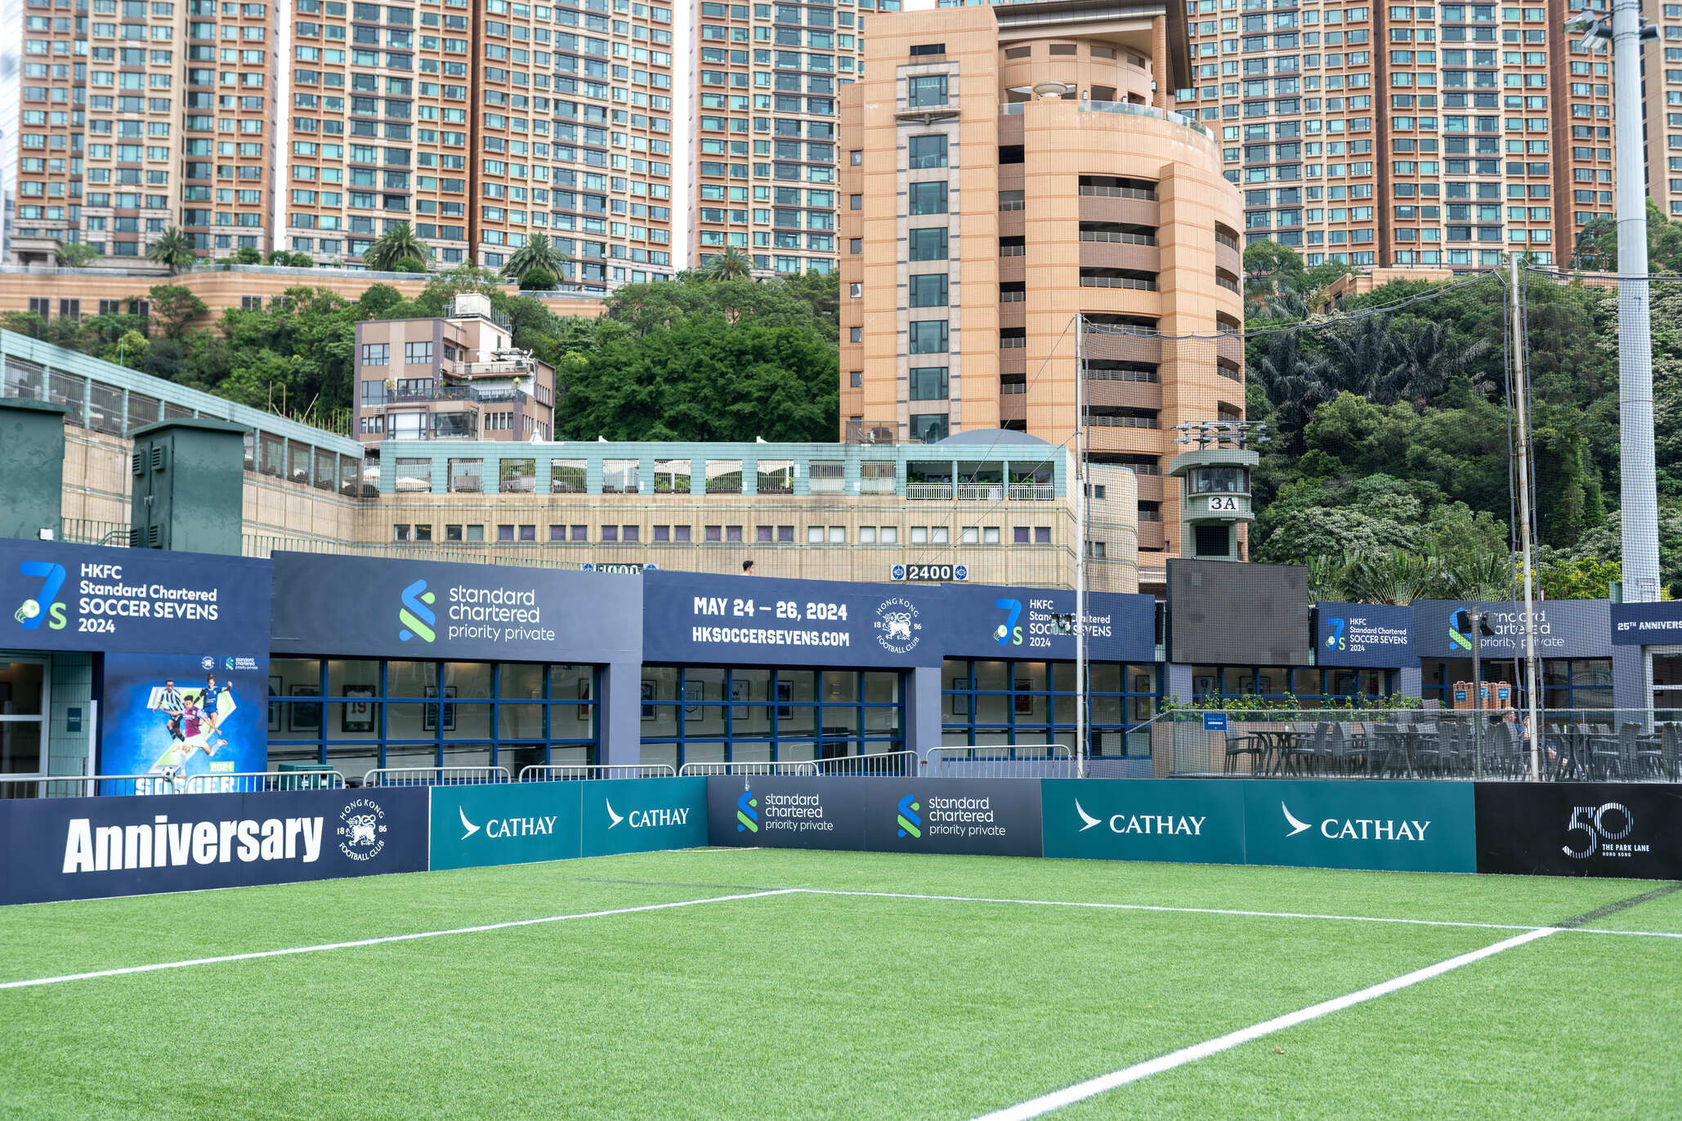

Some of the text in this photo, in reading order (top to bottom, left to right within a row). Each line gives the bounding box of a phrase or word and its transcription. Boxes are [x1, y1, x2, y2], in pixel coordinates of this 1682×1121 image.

[1211, 497, 1236, 510] 3A
[81, 563, 122, 580] HKFC
[909, 566, 951, 579] 2400
[80, 581, 218, 602] Standard Chartered
[449, 585, 535, 606] standard
[79, 598, 219, 621] SOCCER SEVENS
[694, 597, 728, 615] MAY
[733, 599, 754, 617] 24
[776, 601, 802, 621] 26,
[806, 603, 848, 621] 2024
[876, 598, 920, 617] HONG KONG
[1029, 599, 1054, 610] HKFC
[449, 603, 540, 624] chartered
[78, 618, 116, 634] 2024
[1350, 618, 1367, 626] HKFC
[449, 624, 556, 643] priority private
[692, 627, 850, 647] HKSOCCERSEVENS.COM
[1350, 626, 1407, 635] Standard Chartered
[876, 635, 920, 653] FOOTBALL CLUB
[1029, 637, 1051, 647] 2024
[1350, 635, 1408, 645] SOCCER SEVENS
[1350, 644, 1366, 652] 2024
[1480, 637, 1517, 649] priority
[765, 794, 819, 806] standard
[929, 797, 989, 810] standard
[340, 799, 385, 820] HONG KONG
[765, 806, 823, 818] chartered
[929, 810, 994, 823] chartered
[628, 808, 690, 828] CATHAY
[765, 819, 833, 832] priority private
[1109, 815, 1206, 835] CATHAY
[337, 827, 345, 835] 18
[486, 816, 557, 838] CATHAY
[929, 824, 1006, 837] priority private
[1320, 819, 1431, 841] CATHAY
[1562, 802, 1634, 859] 50
[62, 815, 323, 873] Anniversary
[339, 840, 385, 861] FOOTBALL CLUB
[1615, 844, 1632, 852] PARK
